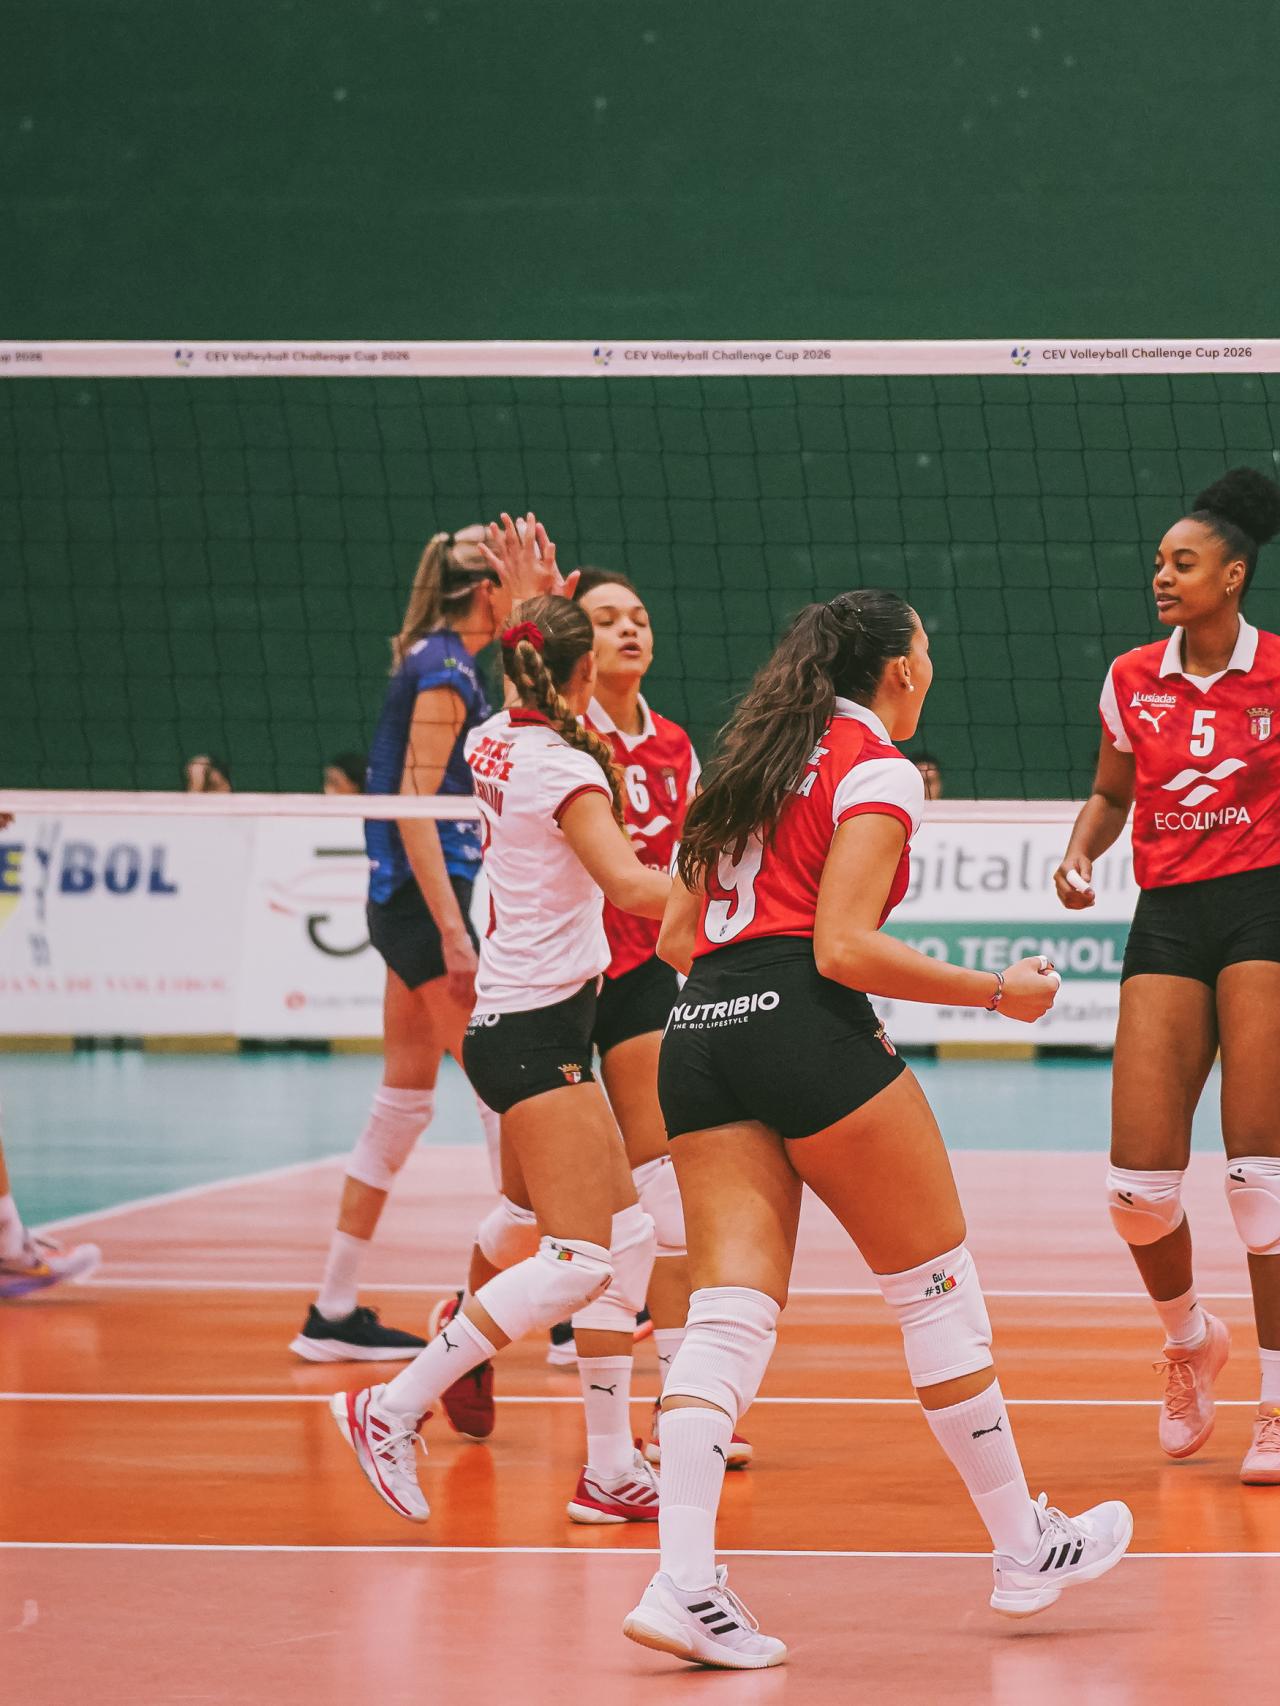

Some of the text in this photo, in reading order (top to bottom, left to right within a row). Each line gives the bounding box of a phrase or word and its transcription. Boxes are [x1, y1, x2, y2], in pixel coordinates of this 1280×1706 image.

[624, 349, 831, 363] CEV Volleyball Challenge Cup 2026
[1042, 347, 1252, 361] CEV Volleyball Challenge Cup 2026
[1189, 709, 1216, 757] 5
[624, 764, 650, 813] 6
[1154, 806, 1252, 831] ECOLIMPA
[663, 991, 780, 1039] NUTRIBIO
[673, 1016, 749, 1030] THE BIO LIFESTYLE
[932, 1269, 946, 1284] Gui
